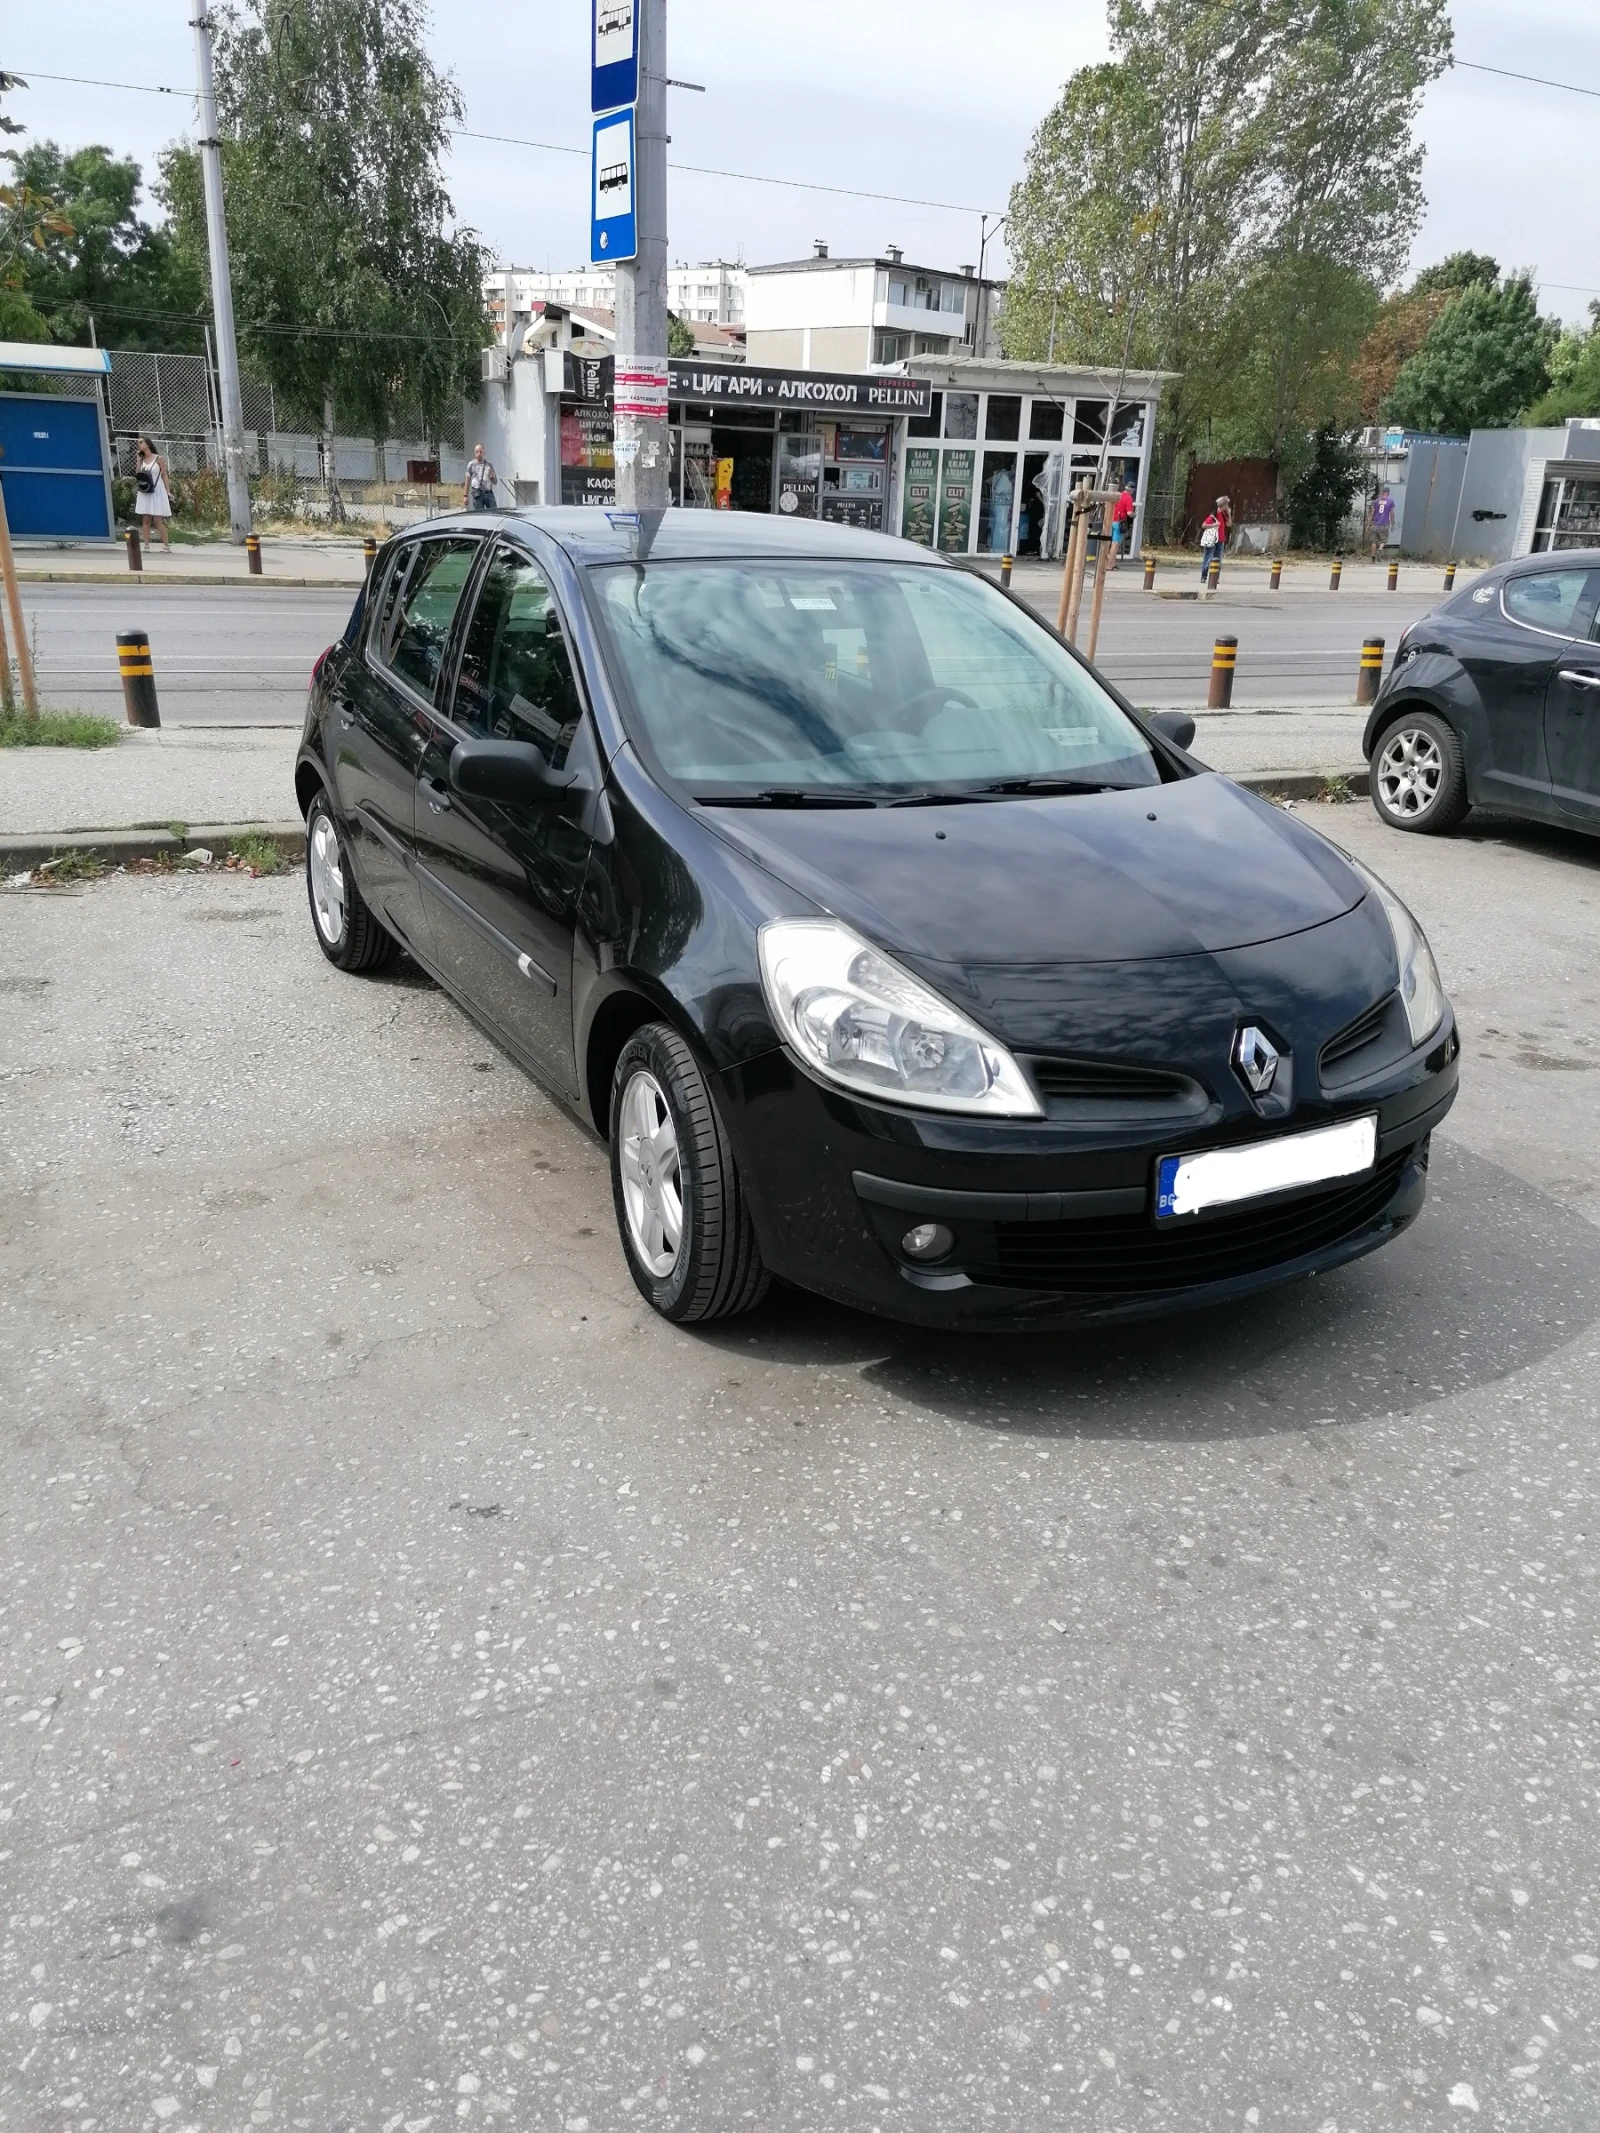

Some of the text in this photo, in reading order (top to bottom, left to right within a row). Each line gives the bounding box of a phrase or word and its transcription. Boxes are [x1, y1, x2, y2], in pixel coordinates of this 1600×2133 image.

[586, 360, 600, 400] Pellini
[877, 378, 918, 388] ESPRESSO
[692, 373, 763, 396] ЦИГАРИ
[778, 380, 858, 403] АЛКОХОЛ
[868, 387, 925, 406] PELLINI
[582, 432, 607, 443] КАФЕ
[580, 447, 613, 456] ВАУЧЕР
[783, 483, 816, 493] PELLINI
[582, 494, 615, 505] ЦИГАР
